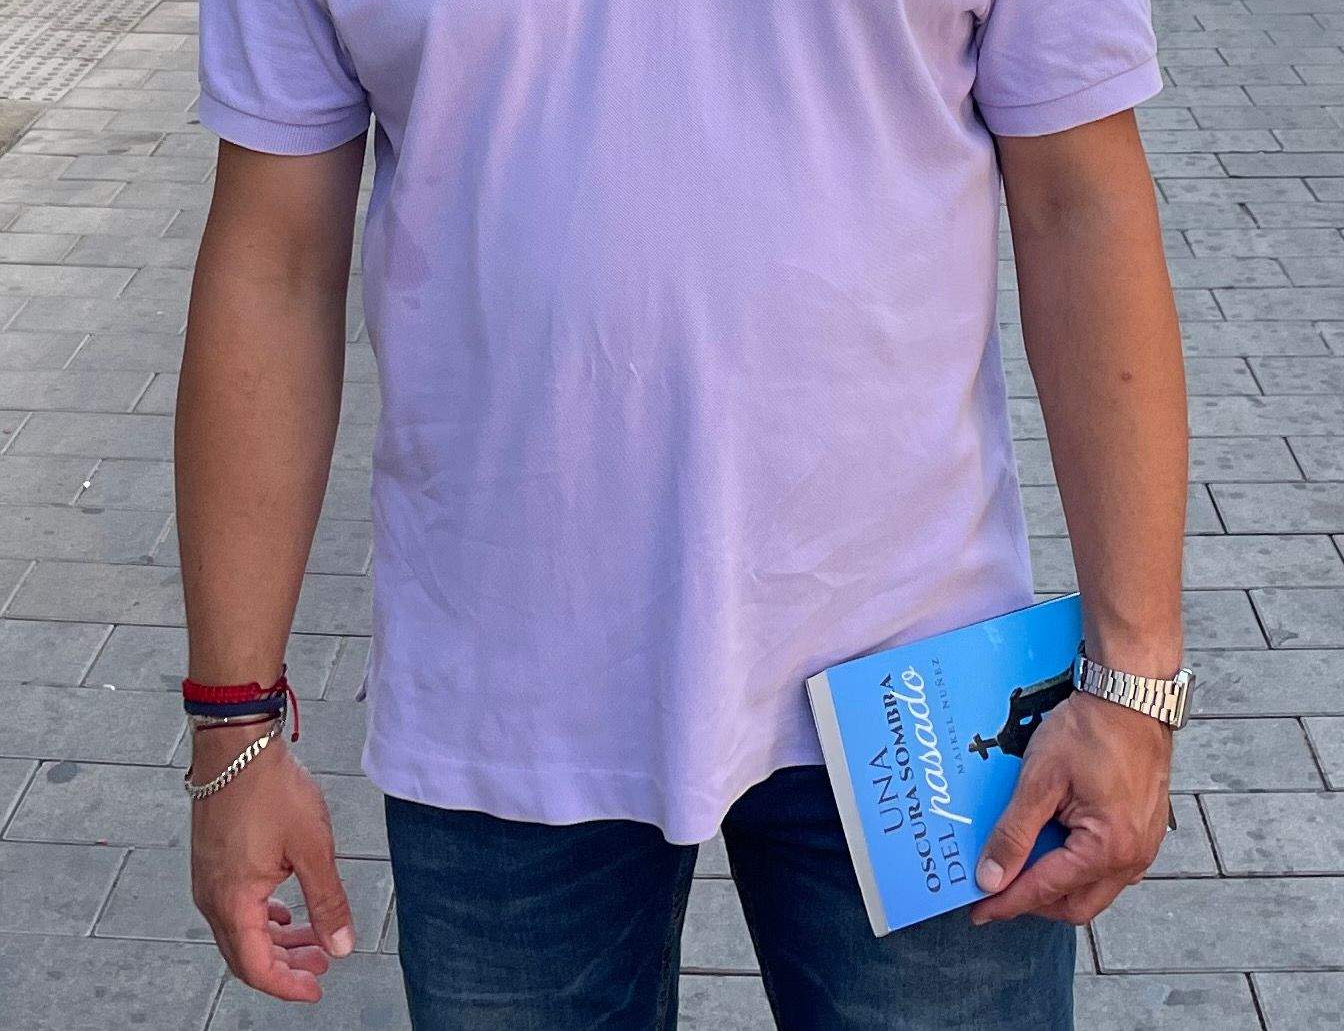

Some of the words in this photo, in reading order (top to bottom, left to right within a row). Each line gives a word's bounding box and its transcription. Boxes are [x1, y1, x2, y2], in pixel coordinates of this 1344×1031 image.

[879, 673, 915, 782] SOMBRA
[890, 666, 973, 825] pasado
[946, 717, 965, 774] MAIKEL
[869, 746, 905, 834] UNA
[906, 785, 942, 893] OSCURA
[938, 822, 967, 886] DEL
